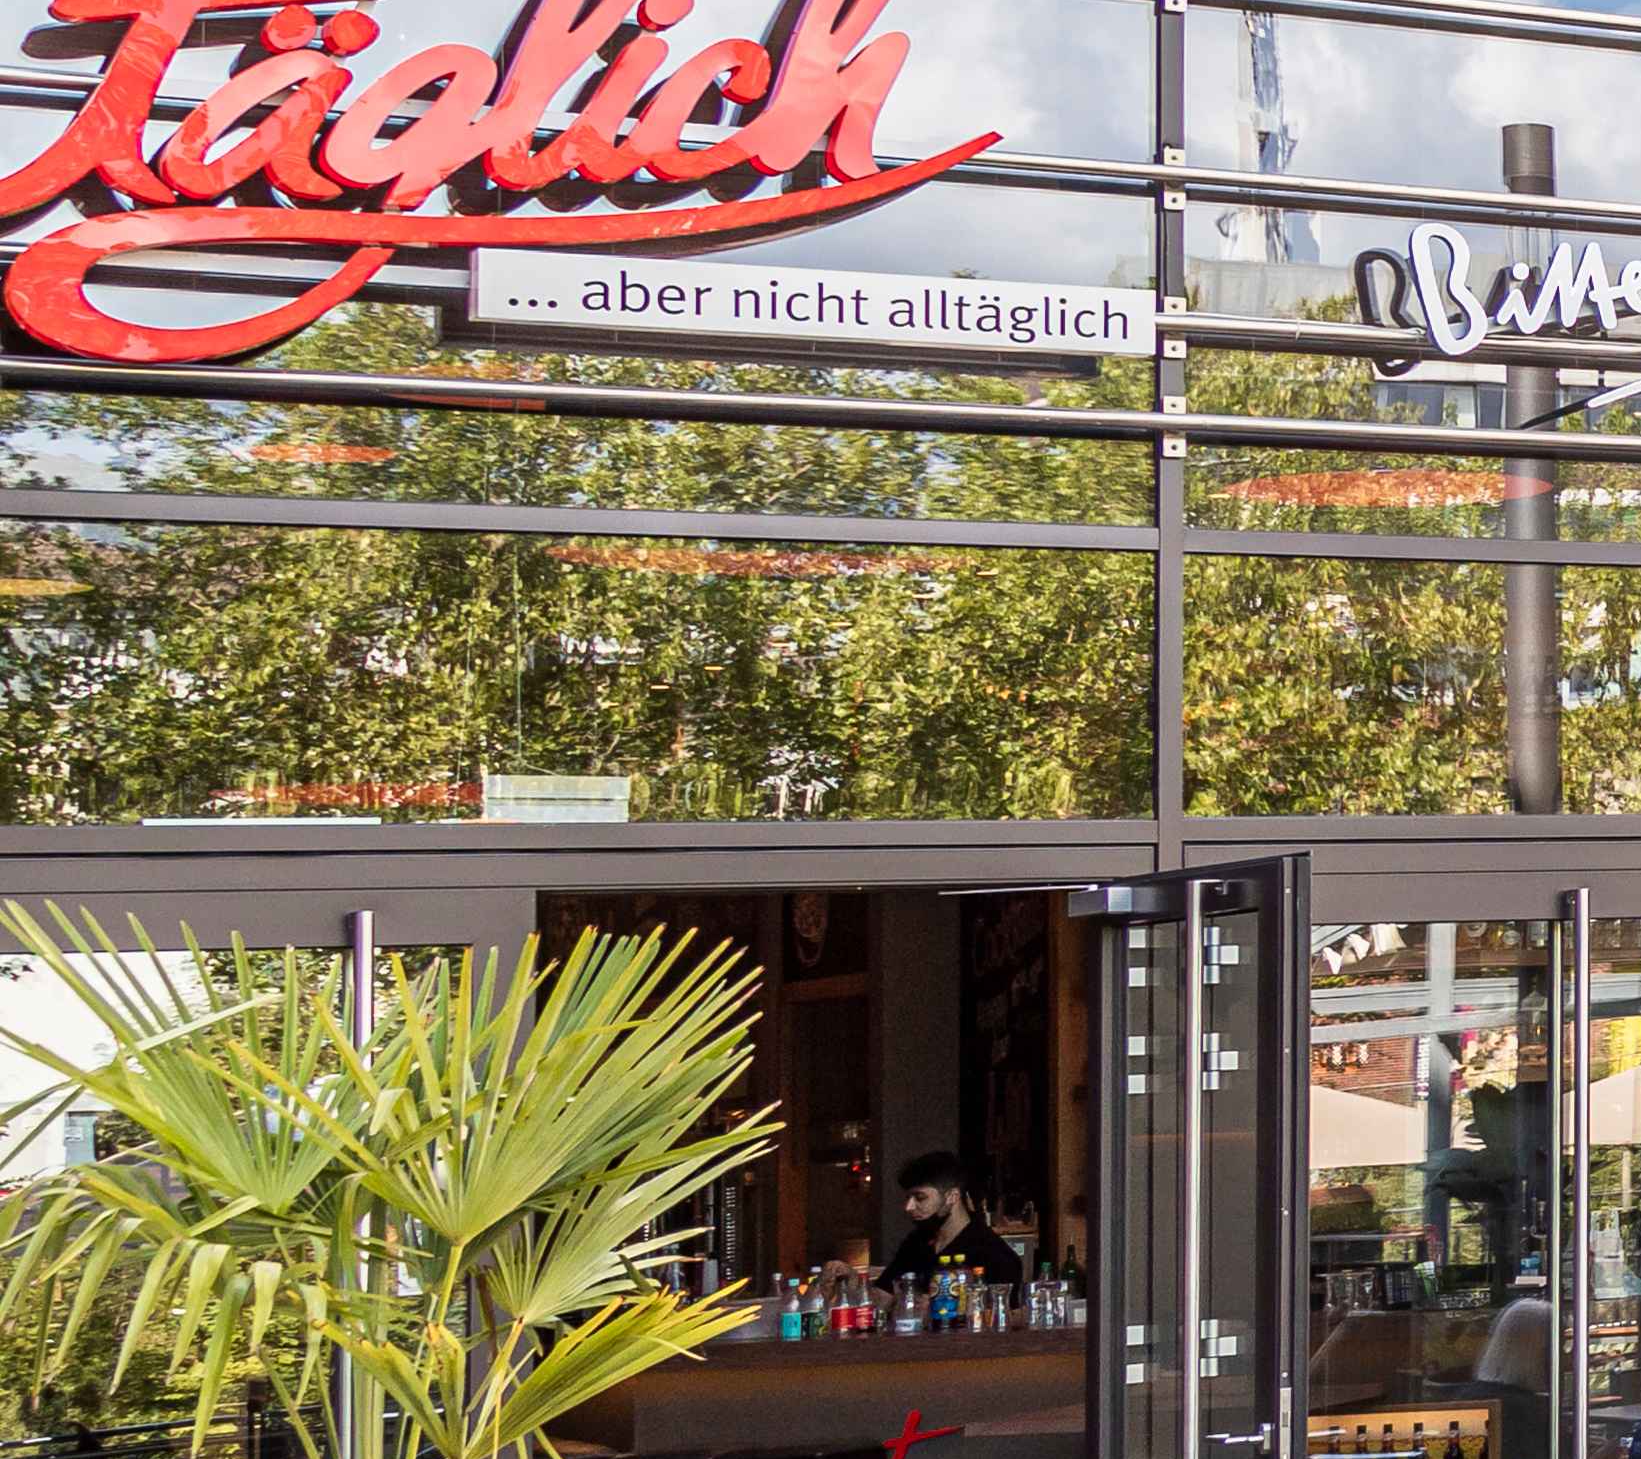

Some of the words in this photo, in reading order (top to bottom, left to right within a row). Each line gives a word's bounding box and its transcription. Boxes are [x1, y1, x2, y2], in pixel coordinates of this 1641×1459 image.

[582, 270, 712, 316] aber
[732, 279, 868, 325] nicht
[888, 288, 1130, 344] alltäglich
